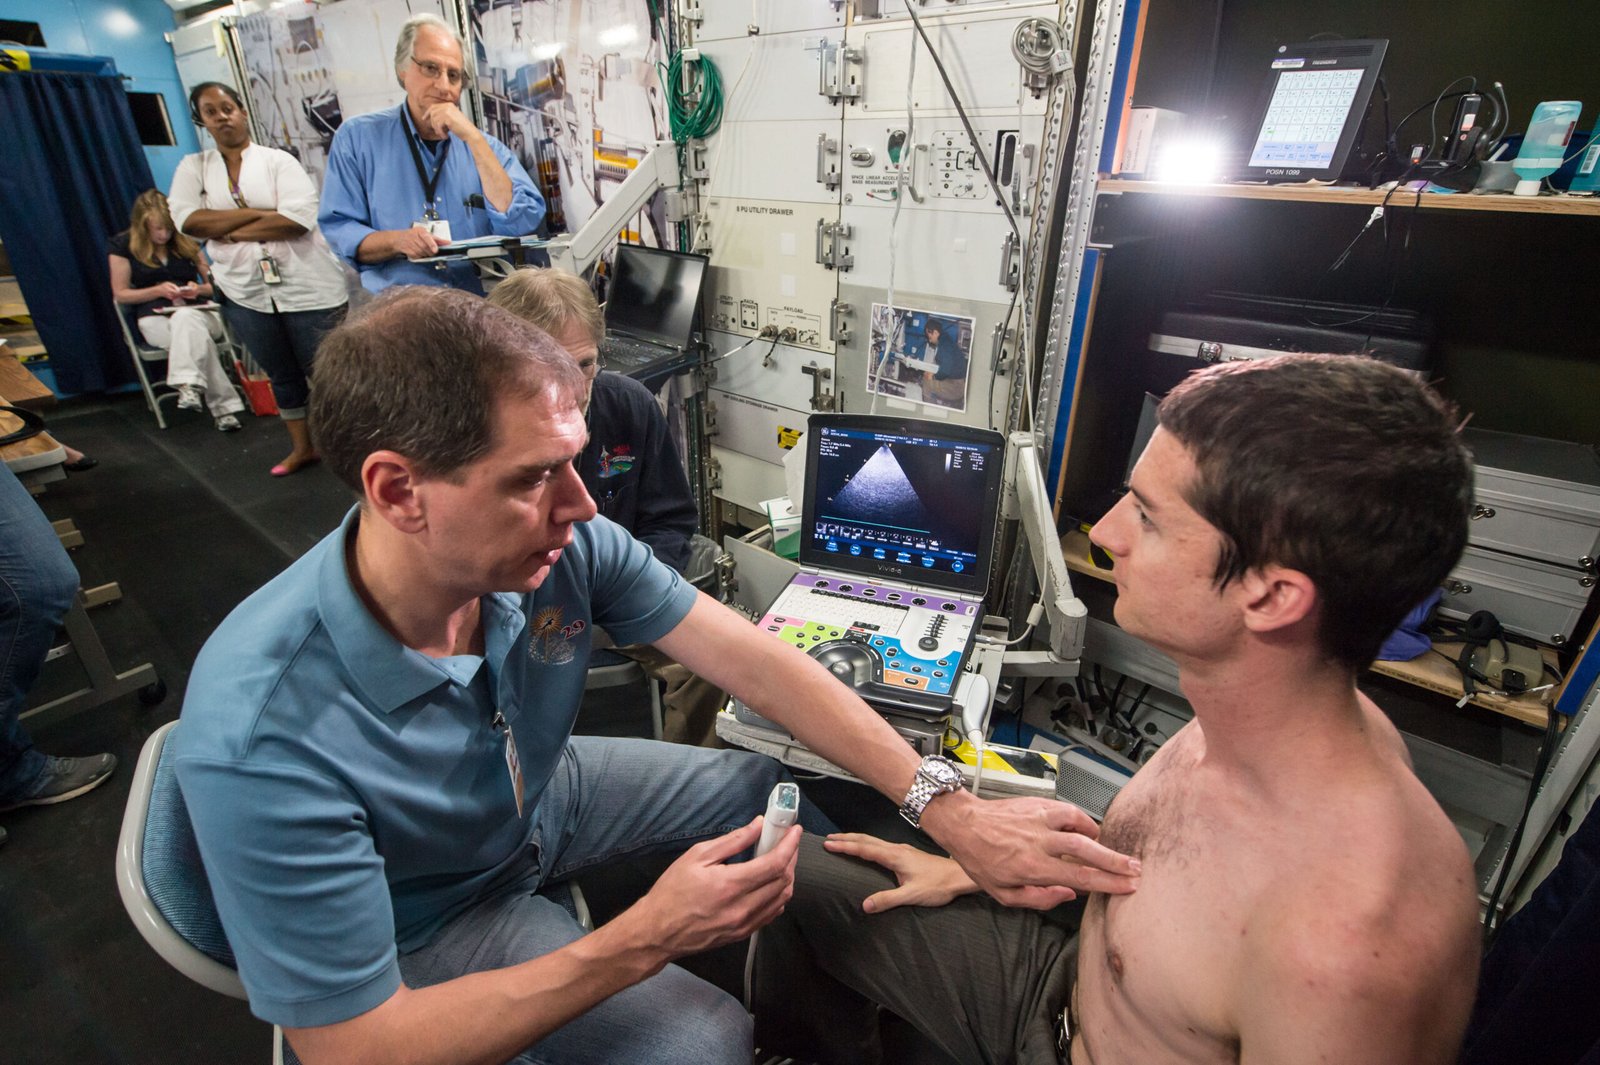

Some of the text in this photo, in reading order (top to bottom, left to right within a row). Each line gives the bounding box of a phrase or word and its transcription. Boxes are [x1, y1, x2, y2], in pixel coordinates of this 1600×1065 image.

[749, 206, 768, 214] UTILITY
[769, 208, 794, 216] DRAWER
[560, 620, 585, 640] 29
